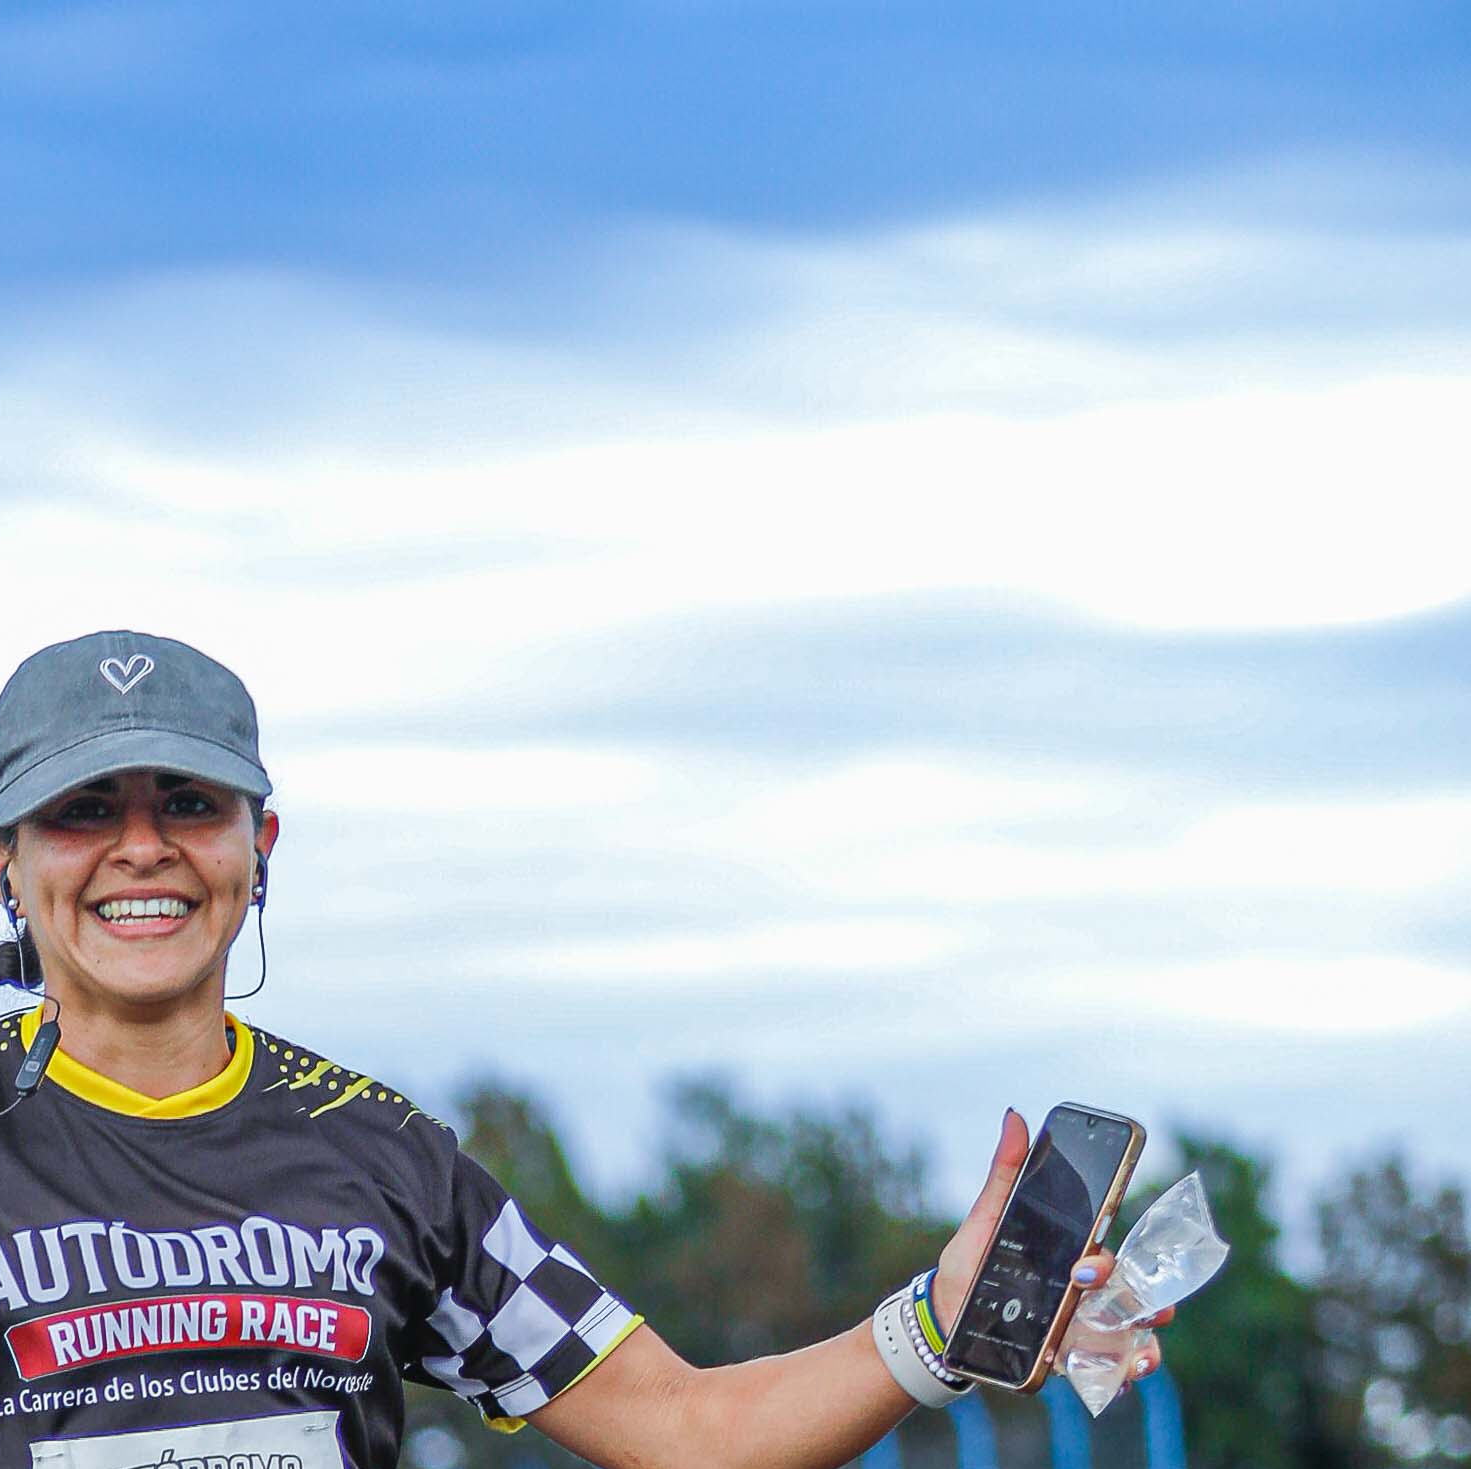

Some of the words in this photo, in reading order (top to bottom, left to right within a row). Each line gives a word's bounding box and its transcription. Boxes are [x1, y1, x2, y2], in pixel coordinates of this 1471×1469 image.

[47, 1300, 228, 1367] RUNNING
[239, 1300, 339, 1351] RACE
[19, 1387, 98, 1413] Carrera
[104, 1377, 135, 1402] de
[140, 1374, 175, 1398] los
[180, 1367, 260, 1395] Clubes
[267, 1366, 301, 1390] del
